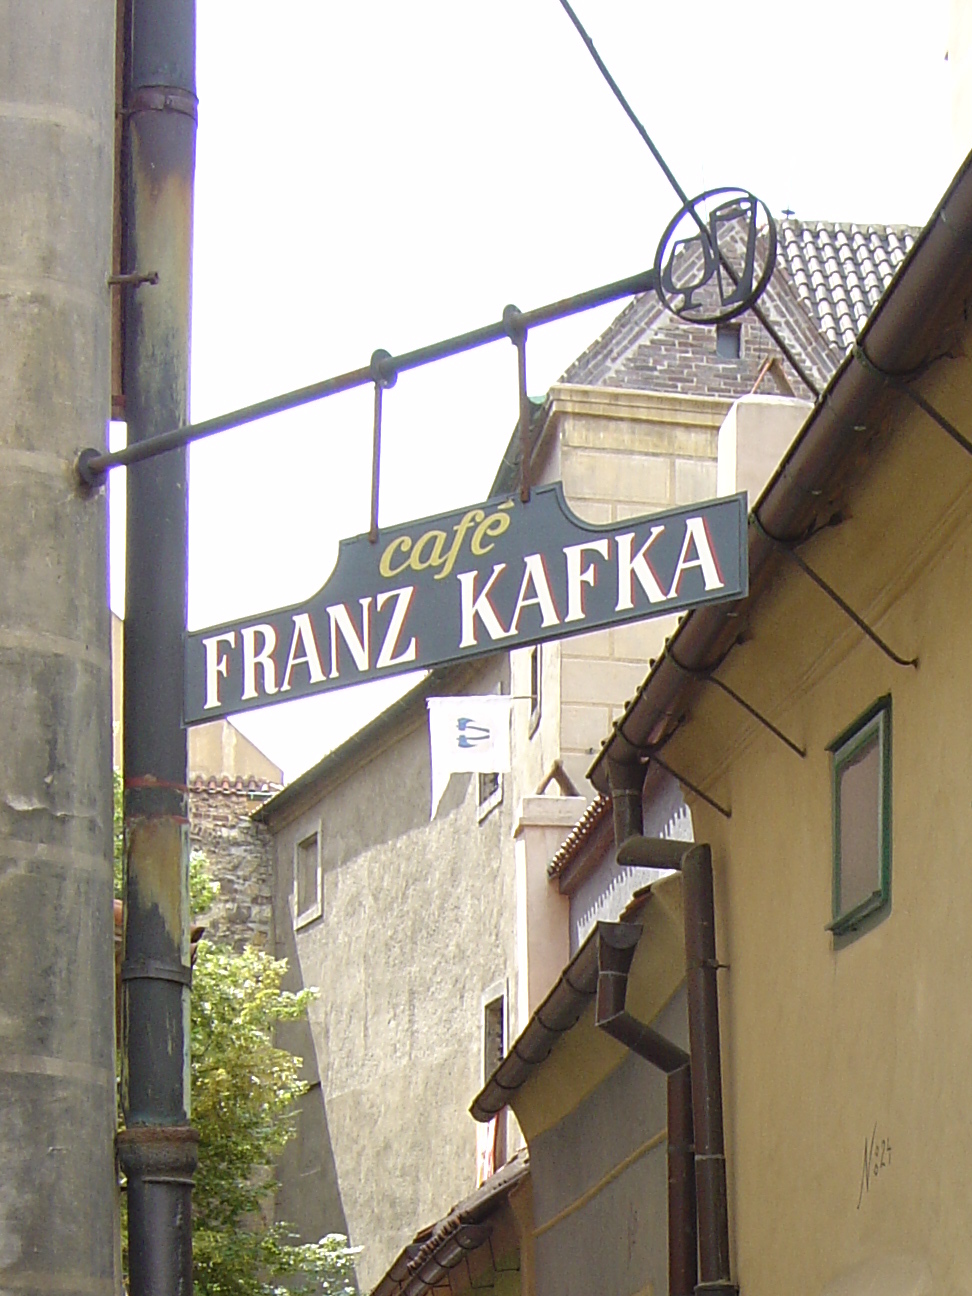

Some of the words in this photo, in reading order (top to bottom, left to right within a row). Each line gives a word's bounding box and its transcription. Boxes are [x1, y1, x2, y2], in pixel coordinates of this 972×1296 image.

[379, 498, 515, 579] café
[202, 586, 417, 710] FRANZ
[457, 516, 725, 649] KAFKA
